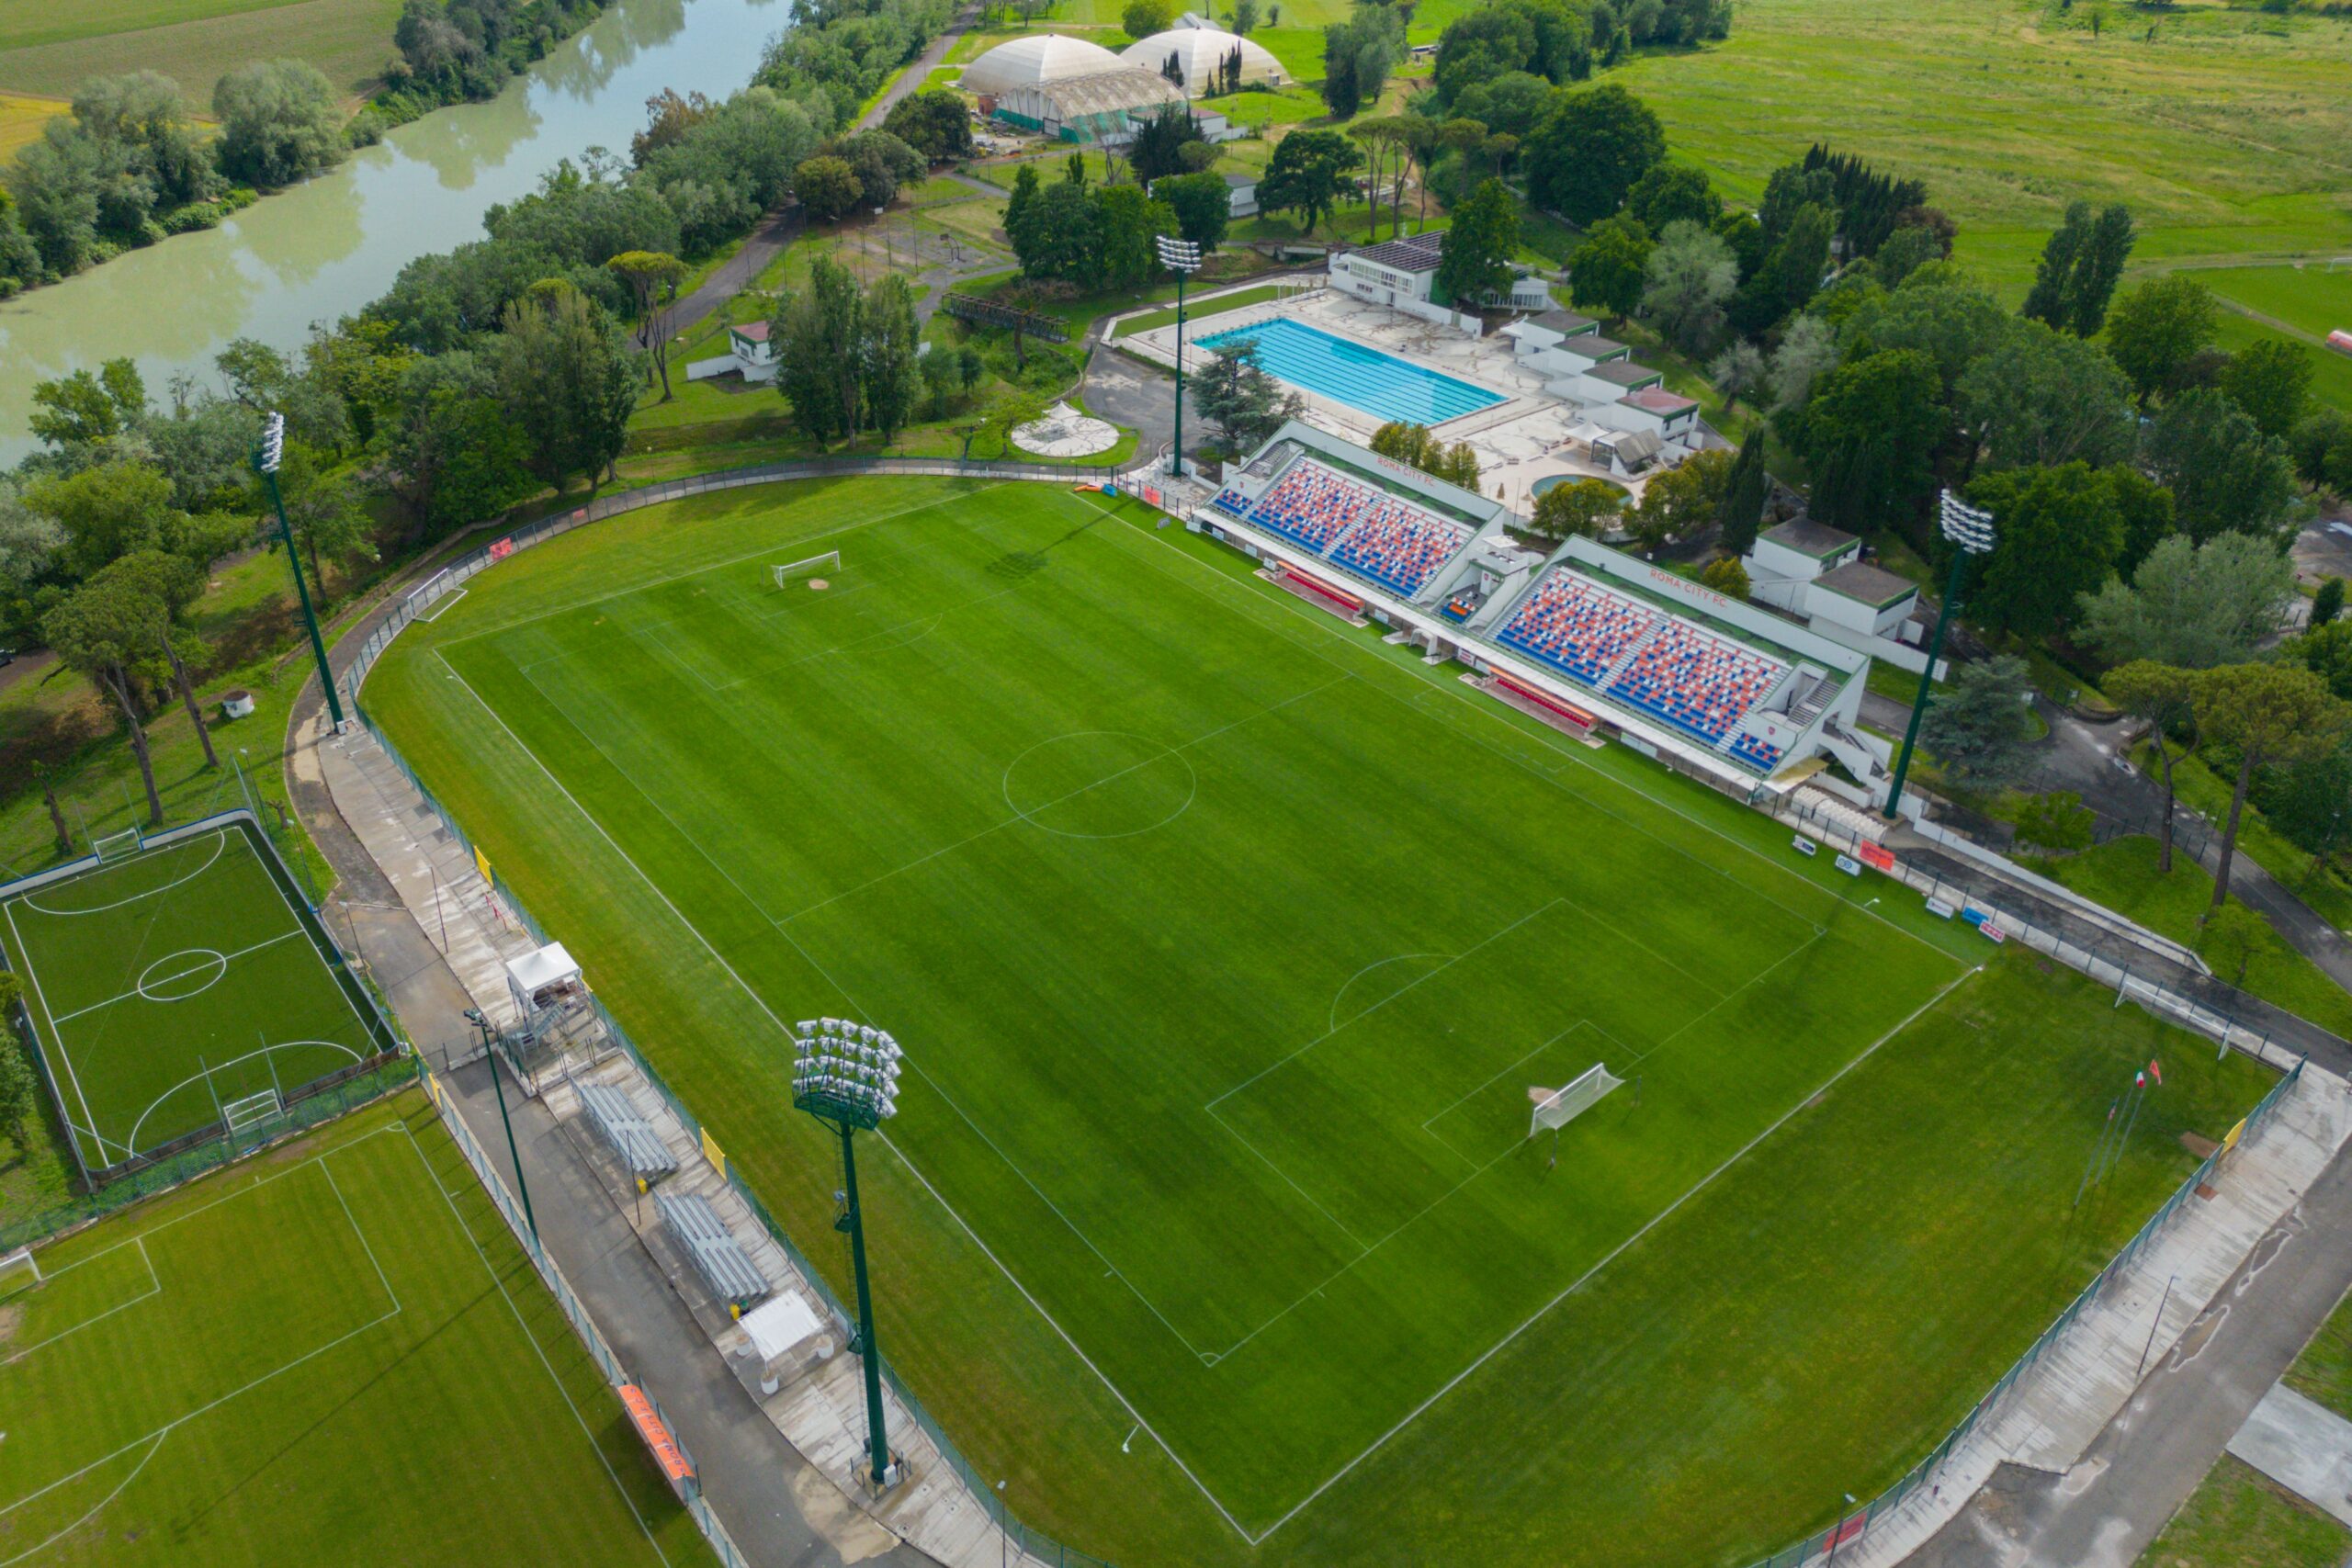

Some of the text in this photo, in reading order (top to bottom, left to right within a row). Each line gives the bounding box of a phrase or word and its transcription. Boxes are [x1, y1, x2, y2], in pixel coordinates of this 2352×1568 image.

[1377, 457, 1400, 472] ROMA
[1403, 468, 1422, 481] CITY
[1650, 569, 1680, 589] ROMA
[1684, 583, 1710, 600] CITY
